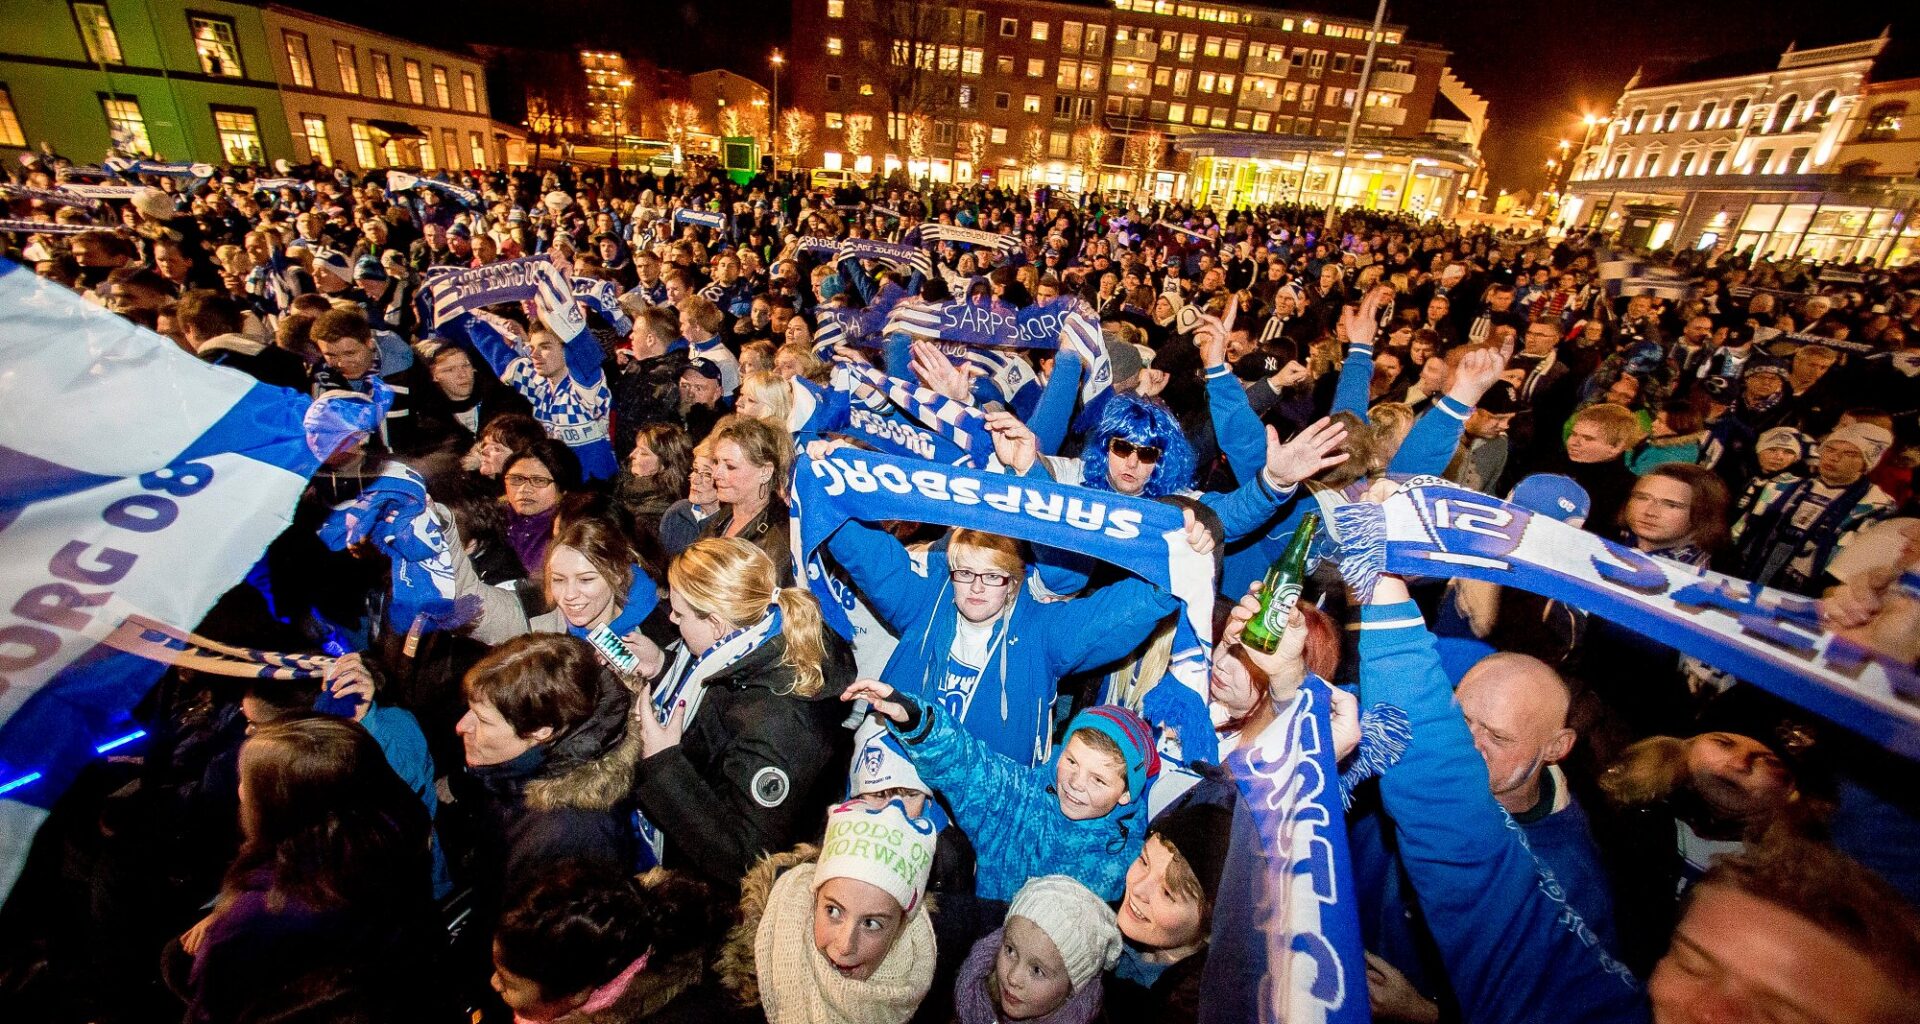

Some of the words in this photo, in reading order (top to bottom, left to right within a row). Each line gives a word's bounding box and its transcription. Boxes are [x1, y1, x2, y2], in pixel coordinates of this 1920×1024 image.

[0, 539, 139, 690] ORG
[102, 461, 215, 533] 08
[810, 458, 1143, 539] SARPSBORG
